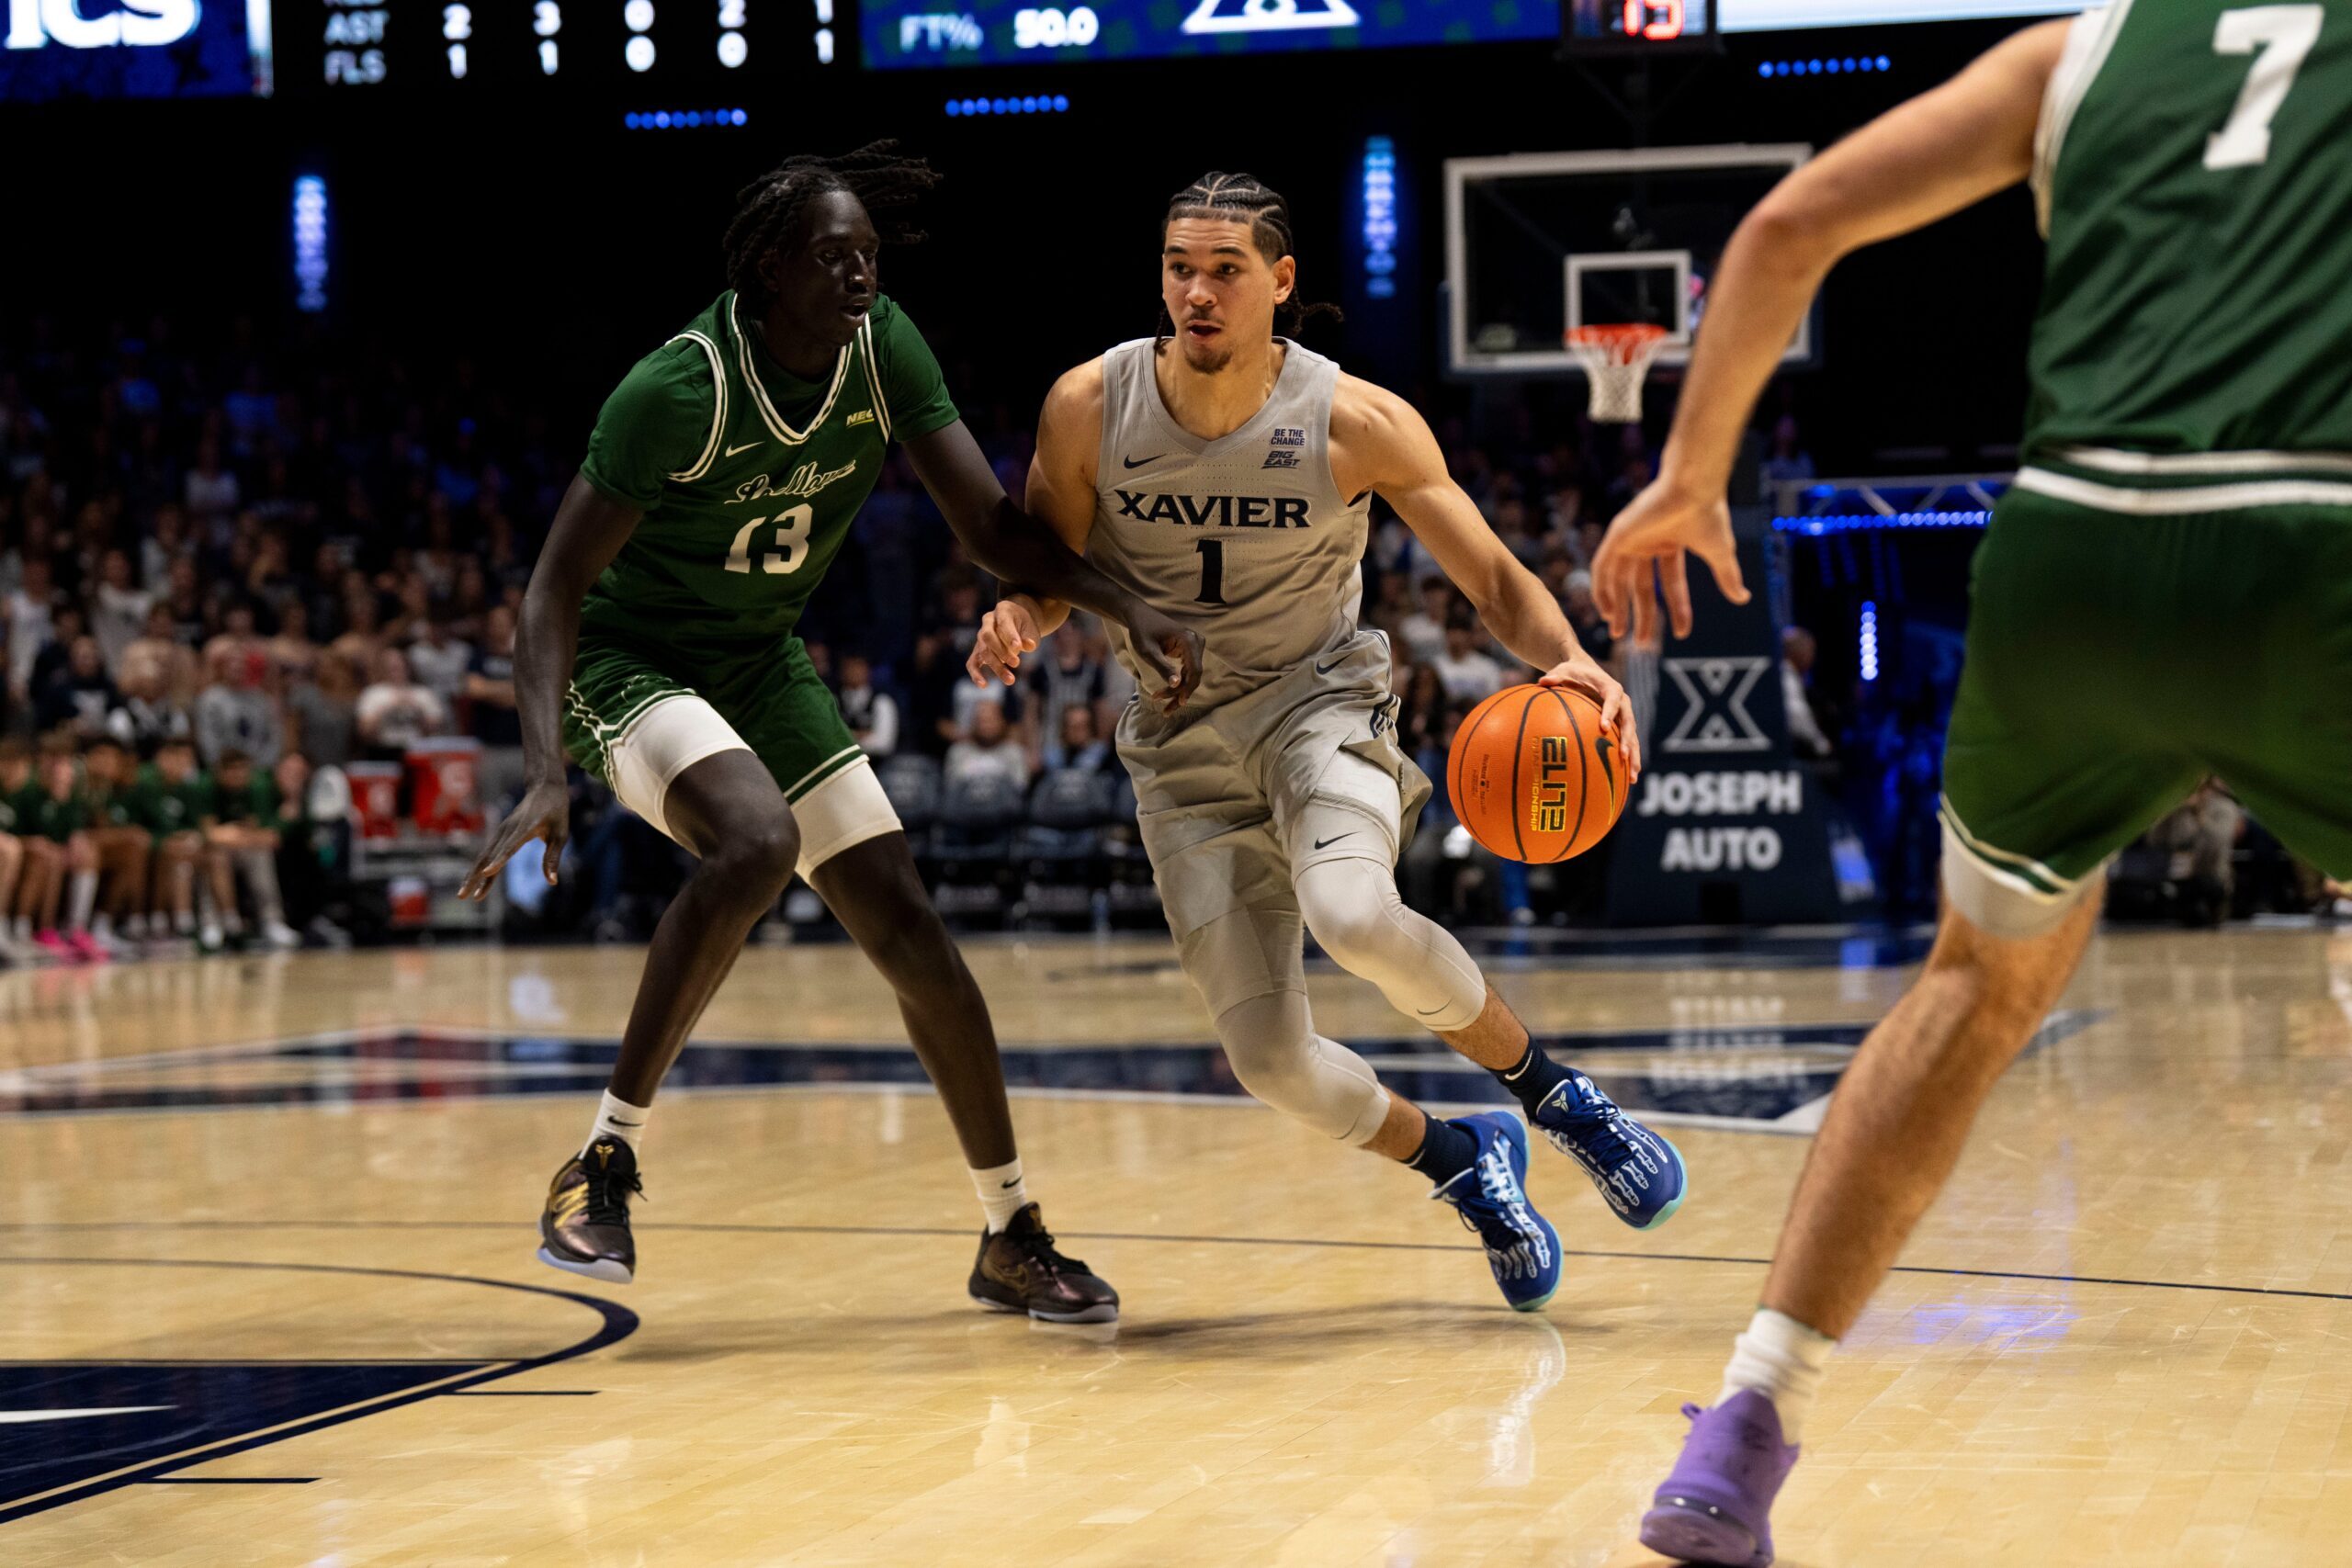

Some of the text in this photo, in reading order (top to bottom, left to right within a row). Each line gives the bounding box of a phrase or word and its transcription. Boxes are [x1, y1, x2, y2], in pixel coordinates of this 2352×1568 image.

[324, 10, 390, 44] AST
[533, 1, 561, 36] 3
[625, 0, 655, 32] 0
[899, 6, 1099, 52] FT% 50.0
[324, 28, 834, 85] FLS 1 1 0 0 1
[2202, 3, 2324, 172] 7
[1268, 450, 1295, 458] BIG
[1271, 436, 1306, 446] CHANGE
[1274, 428, 1305, 438] BE THE
[1263, 458, 1301, 467] EAST
[1114, 489, 1313, 529] XAVIER
[724, 502, 814, 575] 13
[1194, 538, 1228, 604] 1
[1539, 736, 1568, 832] ELITE
[1637, 770, 1803, 816] JOSEPH
[1660, 828, 1784, 873] AUTO
